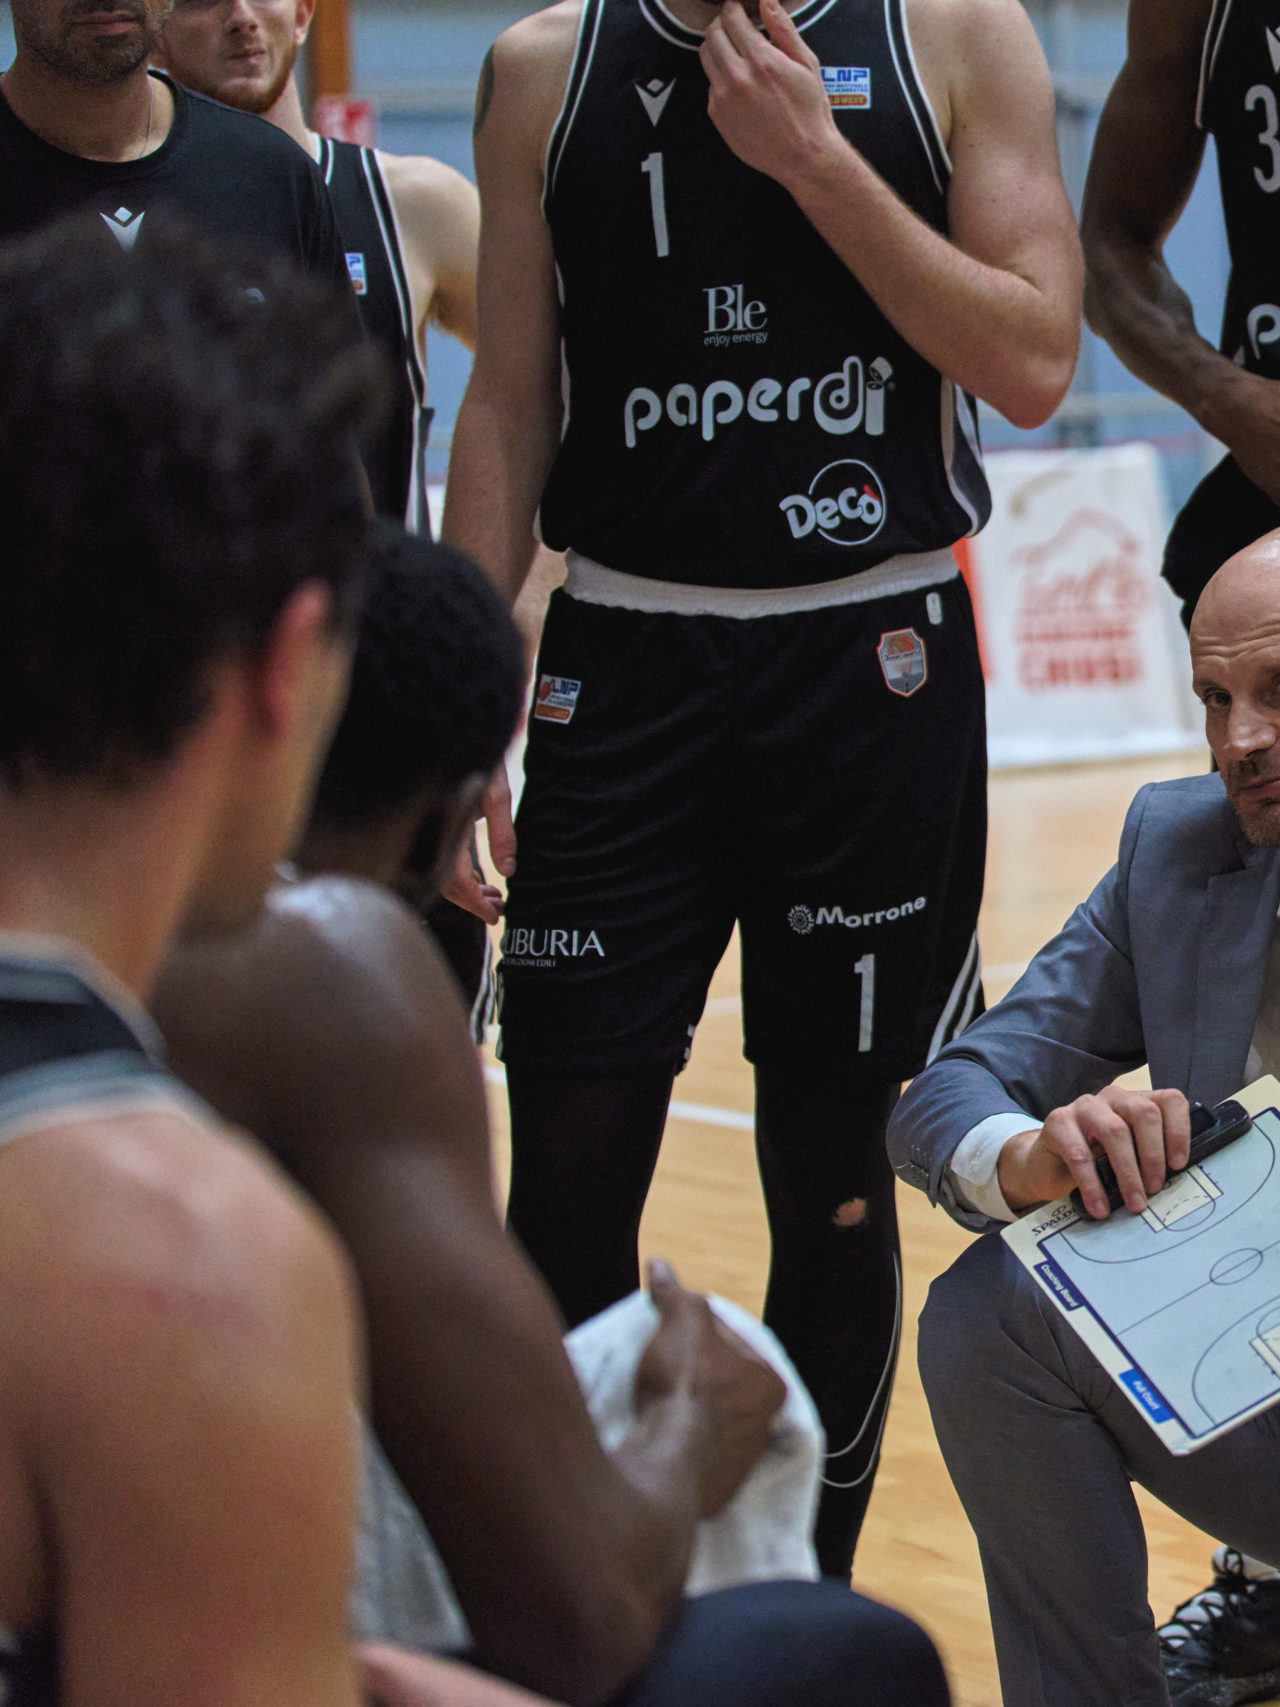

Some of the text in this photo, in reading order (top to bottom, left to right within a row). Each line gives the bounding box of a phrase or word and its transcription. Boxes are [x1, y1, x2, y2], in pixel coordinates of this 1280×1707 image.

[820, 69, 868, 82] LNP
[641, 152, 670, 257] 1
[702, 284, 768, 334] Ble
[703, 331, 769, 347] enjoy energy
[624, 355, 893, 448] paperdi
[815, 896, 927, 929] Morrone
[854, 953, 875, 1052] 1
[1031, 1207, 1076, 1237] SPALD
[1041, 1263, 1080, 1308] Coaching Board
